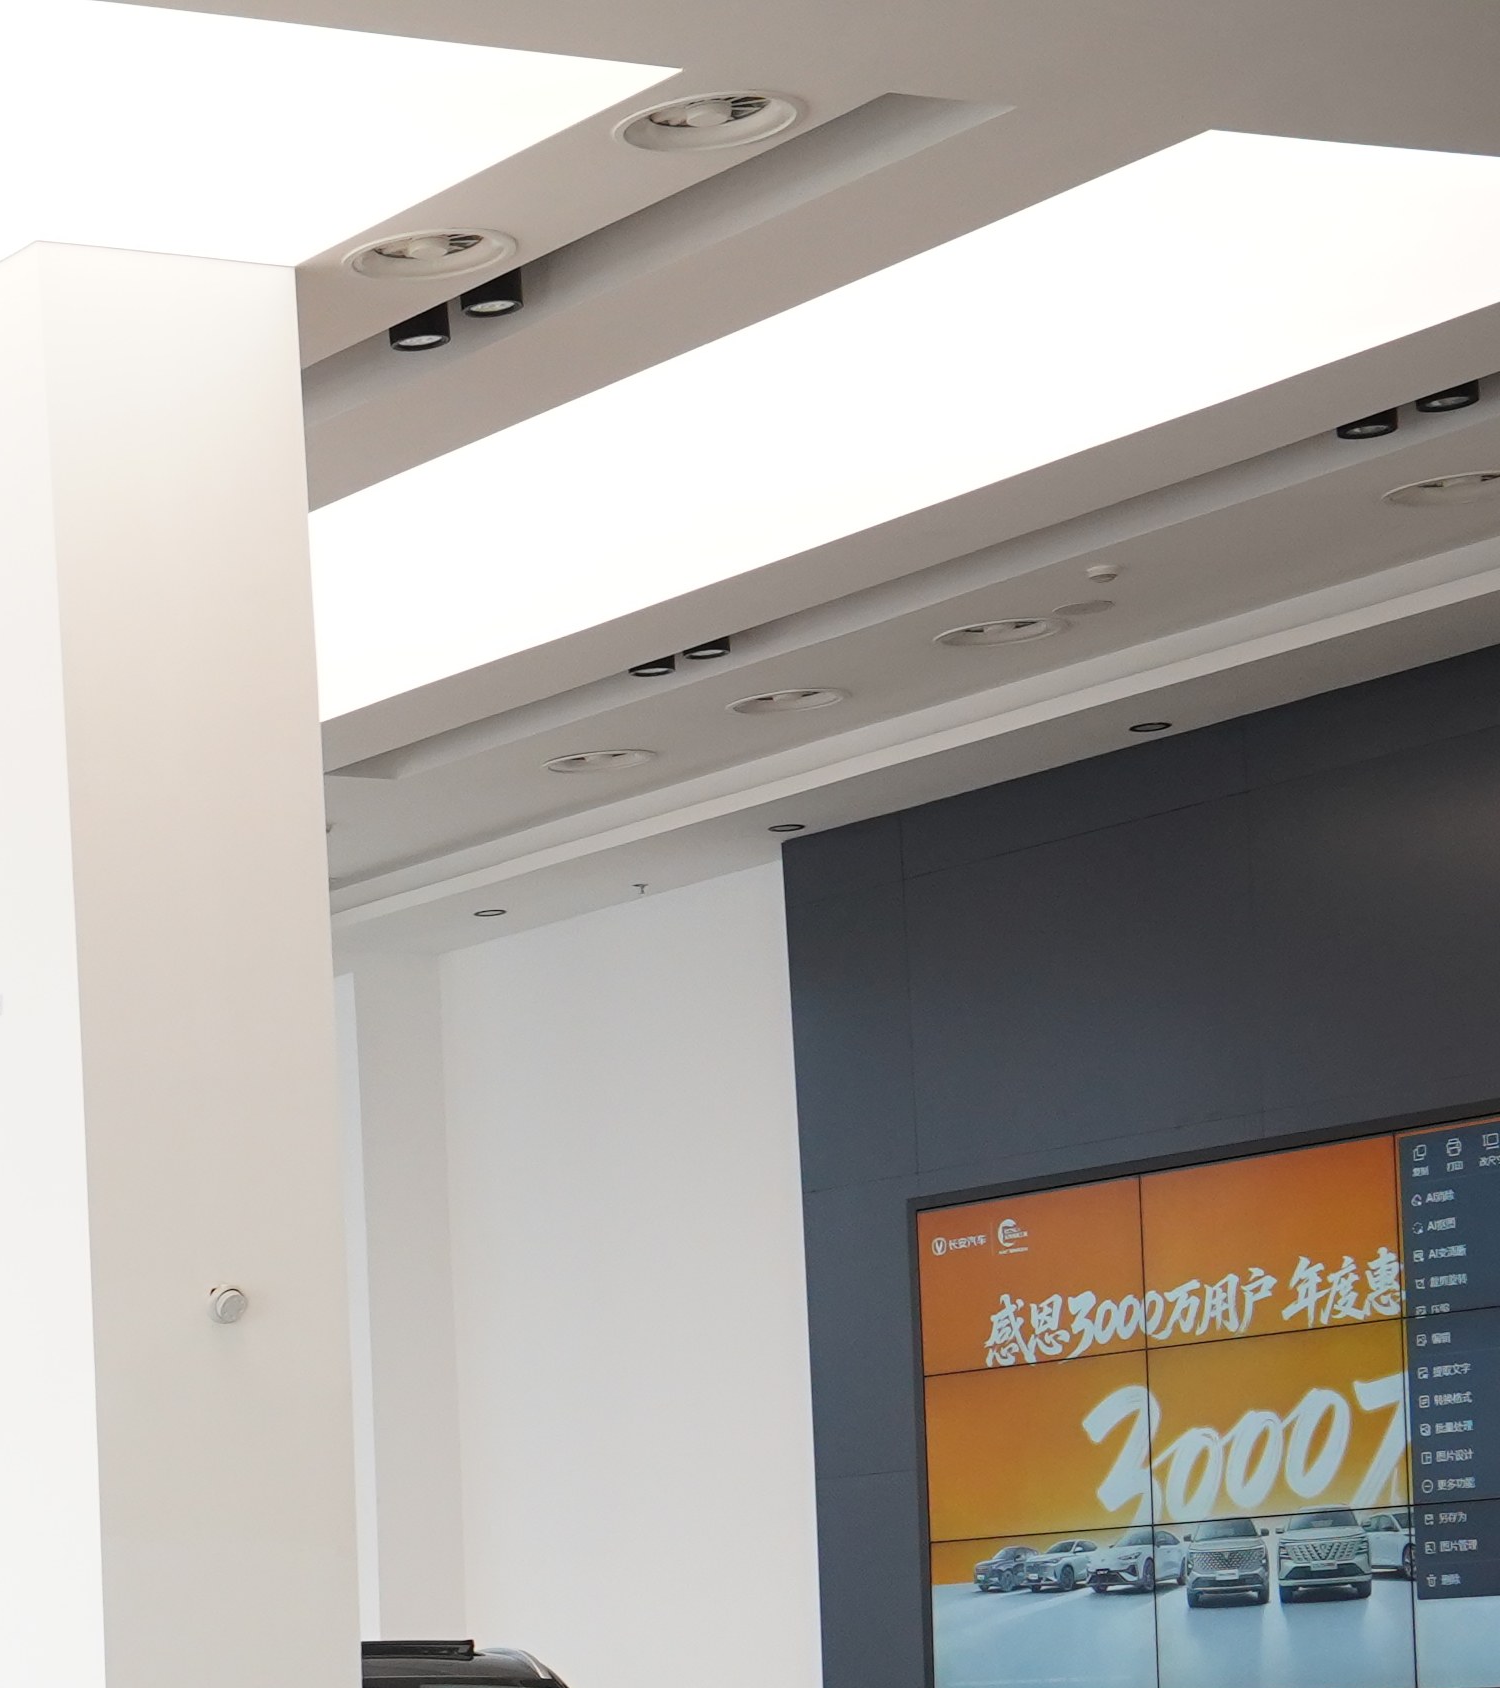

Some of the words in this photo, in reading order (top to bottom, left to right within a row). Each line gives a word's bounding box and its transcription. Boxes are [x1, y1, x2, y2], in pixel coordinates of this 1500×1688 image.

[984, 1267, 1277, 1367] 感恩3000万用户
